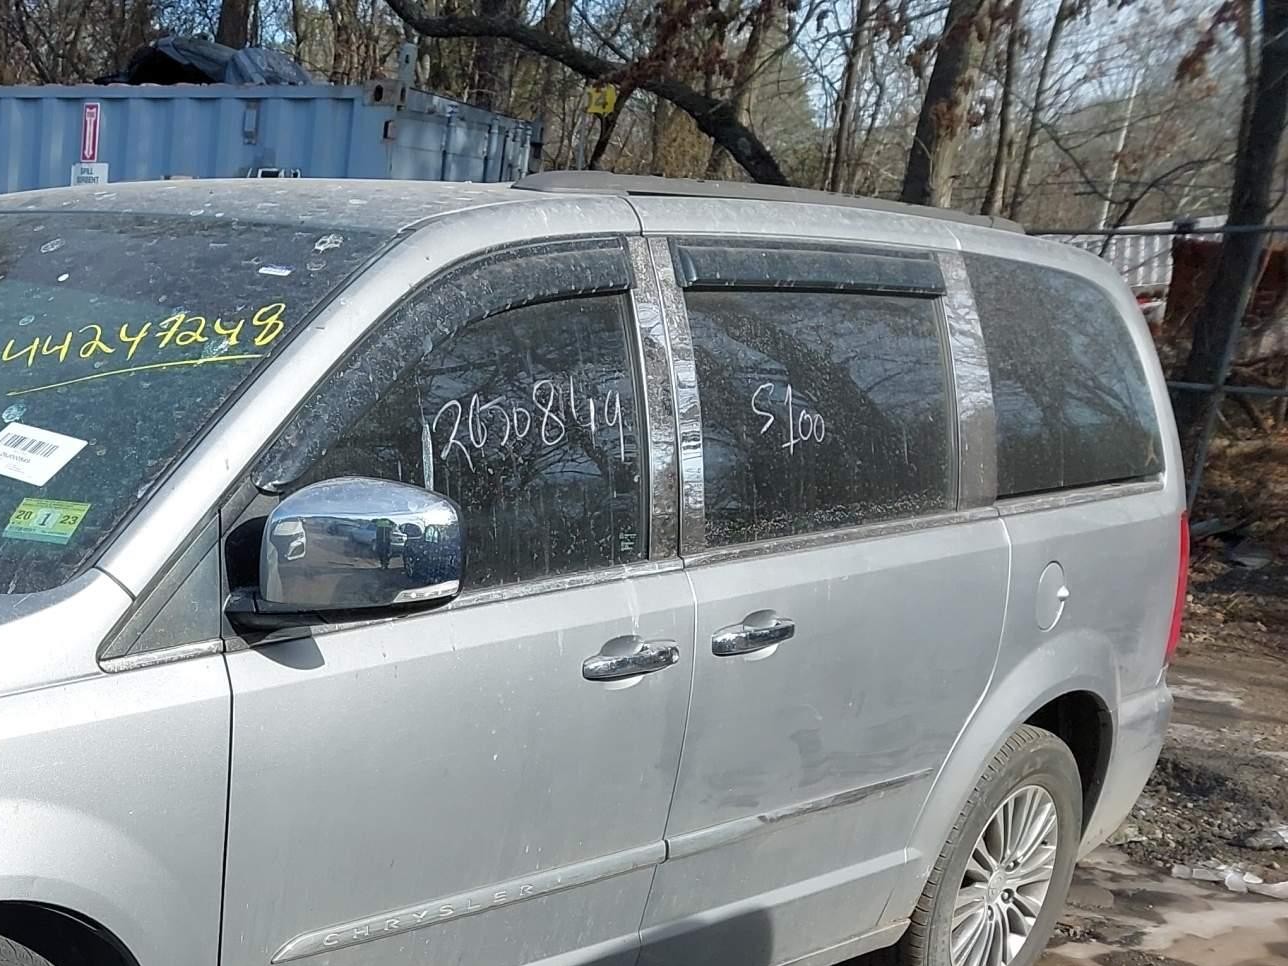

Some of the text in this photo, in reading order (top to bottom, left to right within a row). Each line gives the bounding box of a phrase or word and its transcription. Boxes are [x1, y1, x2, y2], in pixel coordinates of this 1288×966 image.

[1, 302, 286, 367] 44247248
[14, 509, 79, 527] 20 1 23
[322, 883, 534, 947] CHRYSLER
